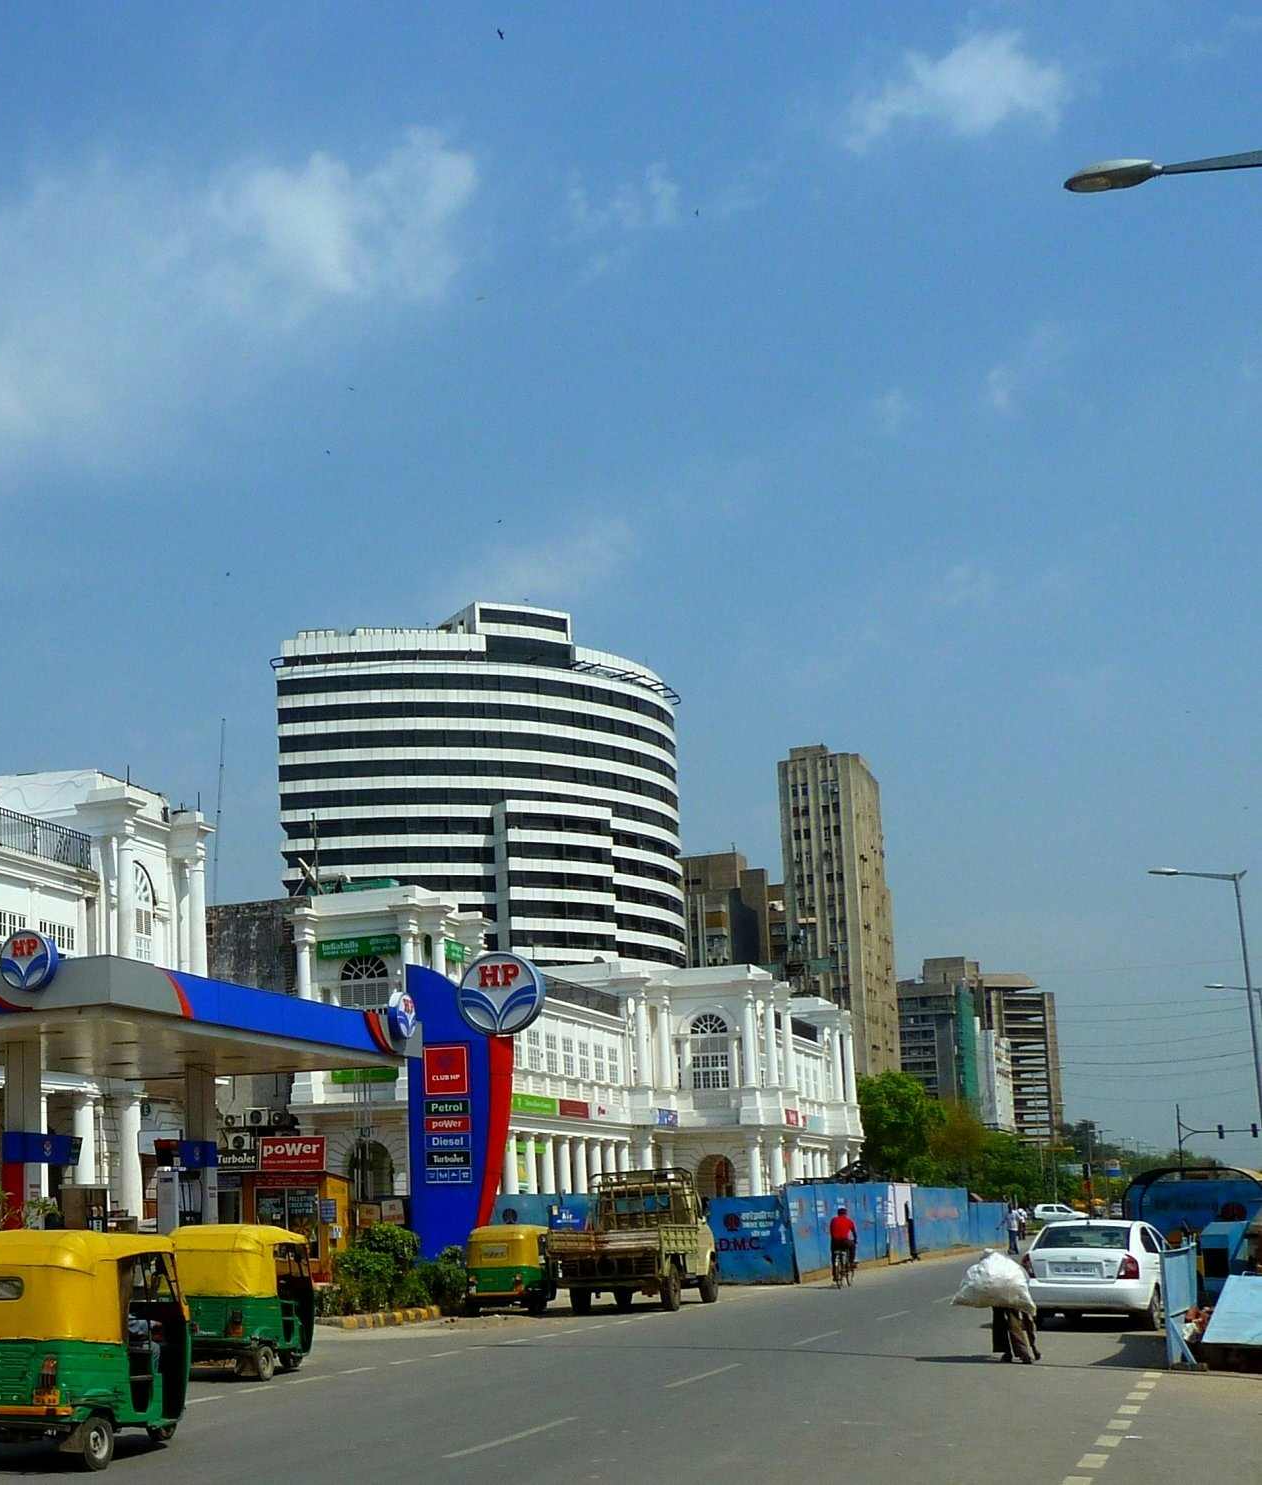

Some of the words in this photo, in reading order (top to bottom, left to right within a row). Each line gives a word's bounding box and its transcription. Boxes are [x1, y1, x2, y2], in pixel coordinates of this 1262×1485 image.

[12, 938, 38, 958] HP
[478, 963, 521, 987] HP
[431, 1102, 463, 1112] Petrol
[431, 1119, 462, 1129] poWer
[431, 1136, 464, 1146] Diesel
[262, 1142, 320, 1157] poWer
[216, 1152, 256, 1164] TurboJet
[433, 1153, 464, 1163] TurboJet
[562, 1212, 573, 1220] Air
